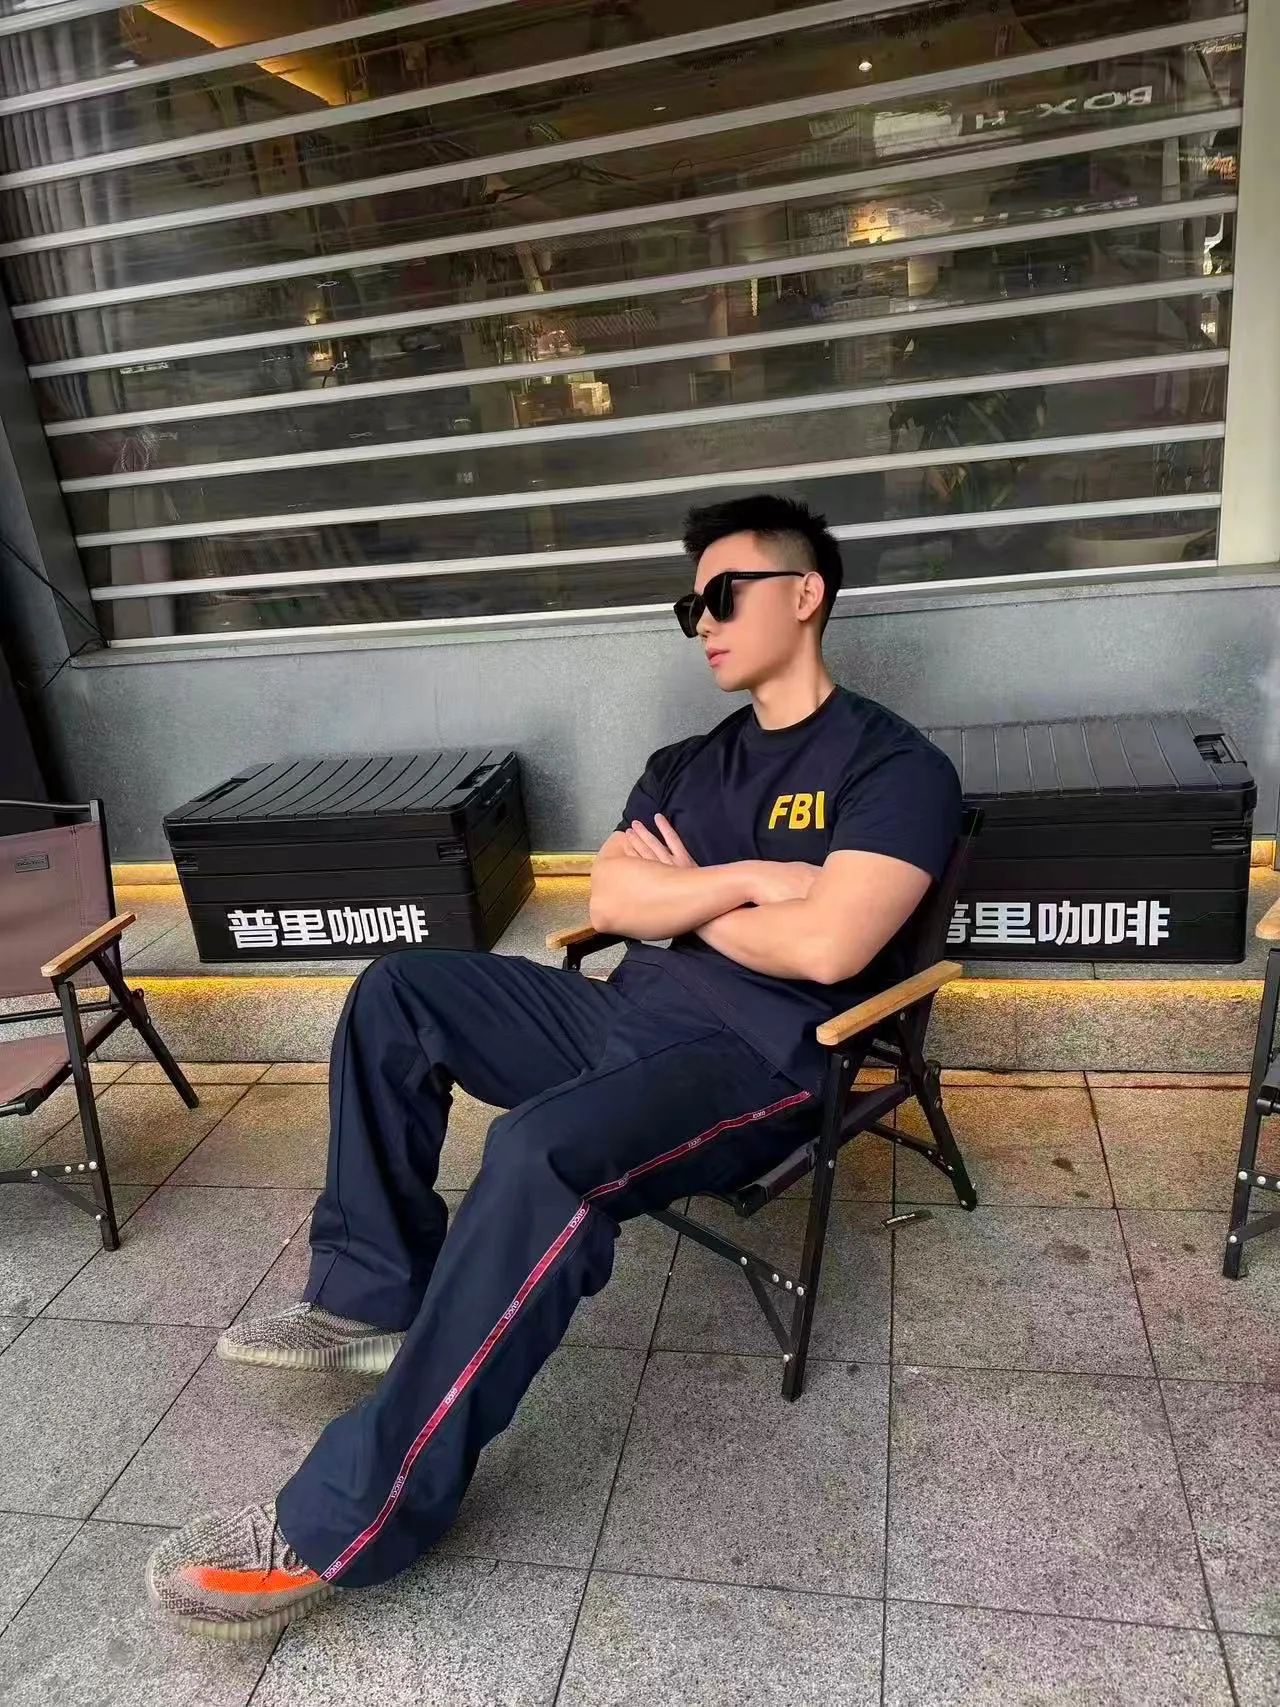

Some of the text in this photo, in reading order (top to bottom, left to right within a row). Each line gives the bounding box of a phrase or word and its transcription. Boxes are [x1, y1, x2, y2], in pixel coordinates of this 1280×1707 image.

[768, 791, 825, 830] FBI
[227, 904, 429, 949] 普里咖啡
[569, 1208, 586, 1228] GUCCI
[503, 1300, 520, 1320] GUCCI
[390, 1475, 404, 1498] GUCCI
[324, 1560, 342, 1578] GUCCI
